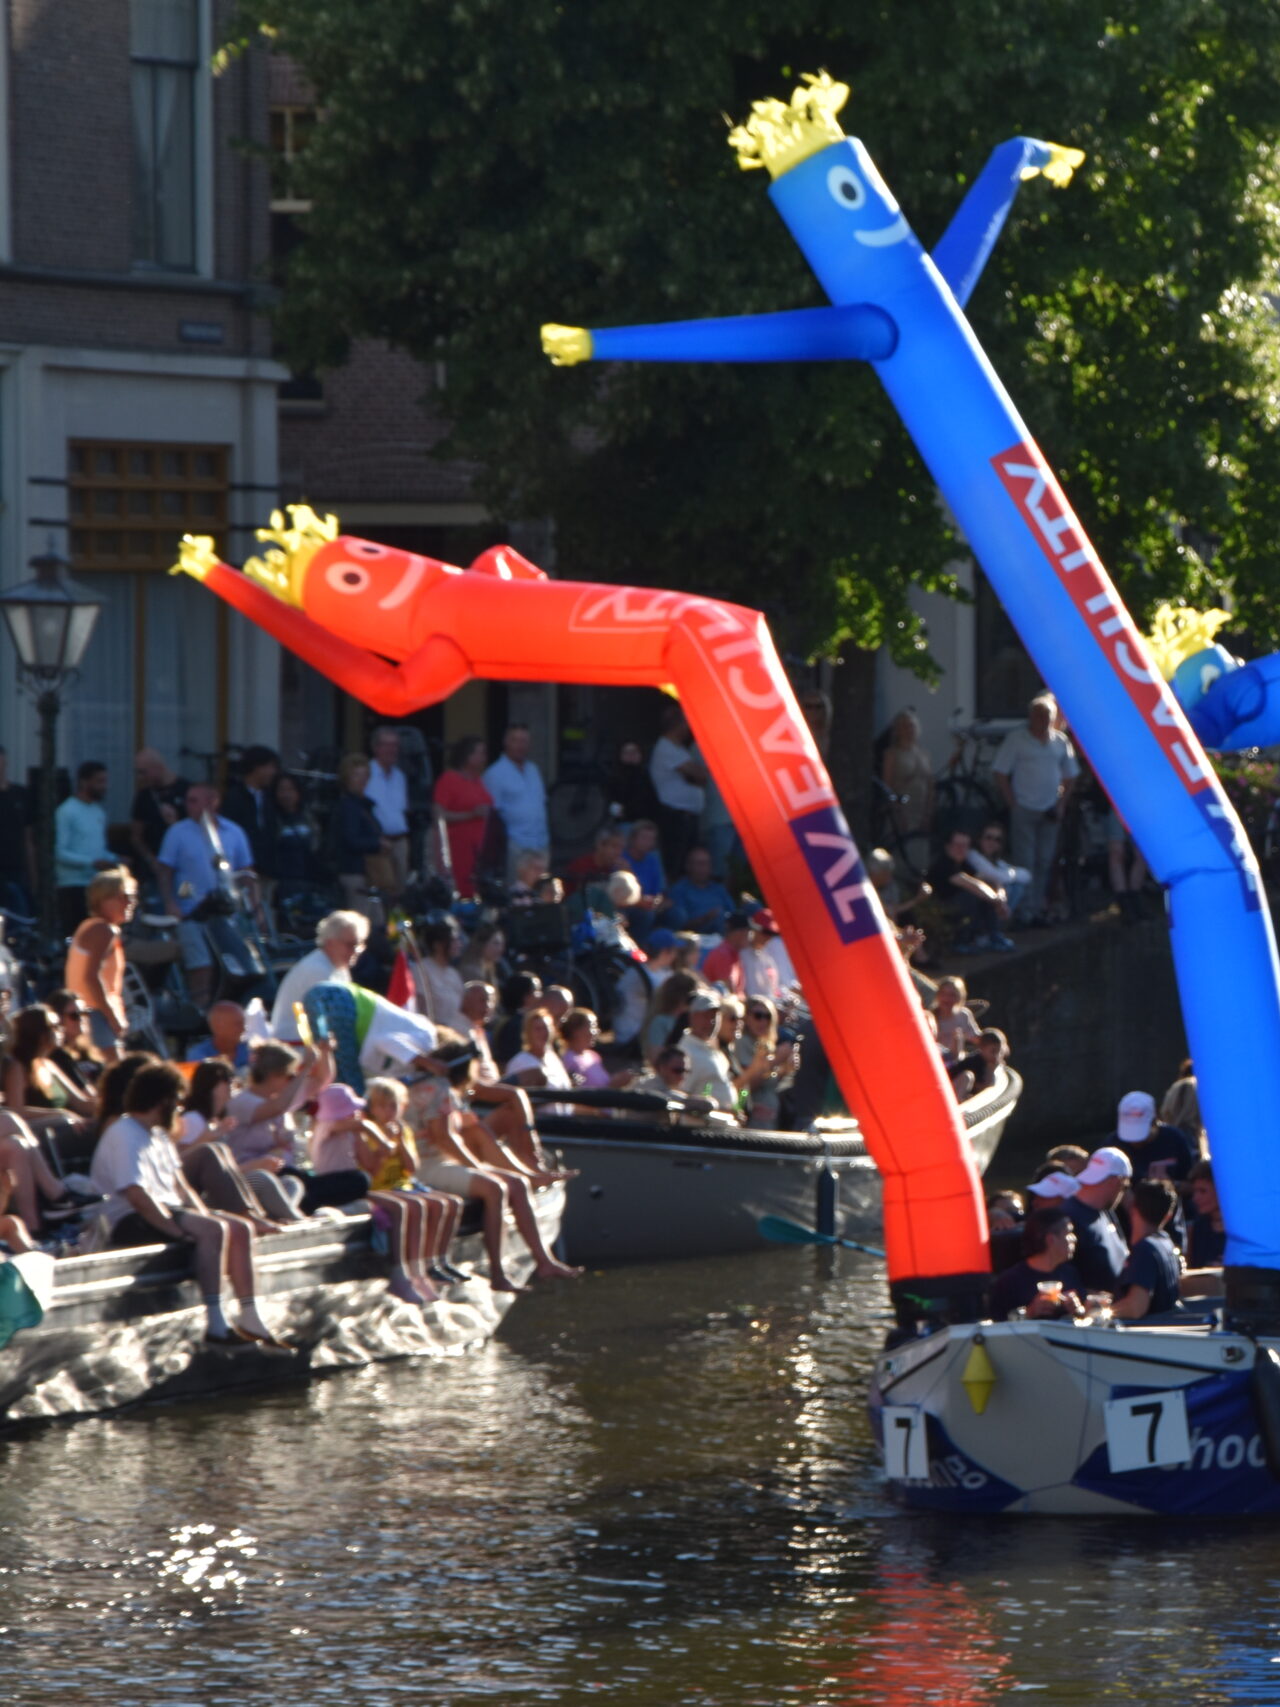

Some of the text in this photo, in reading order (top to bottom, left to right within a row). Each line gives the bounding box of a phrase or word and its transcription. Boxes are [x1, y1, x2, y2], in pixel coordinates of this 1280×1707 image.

[580, 586, 836, 811] FACILITY
[894, 1417, 912, 1477] 7
[1130, 1402, 1163, 1464] 7
